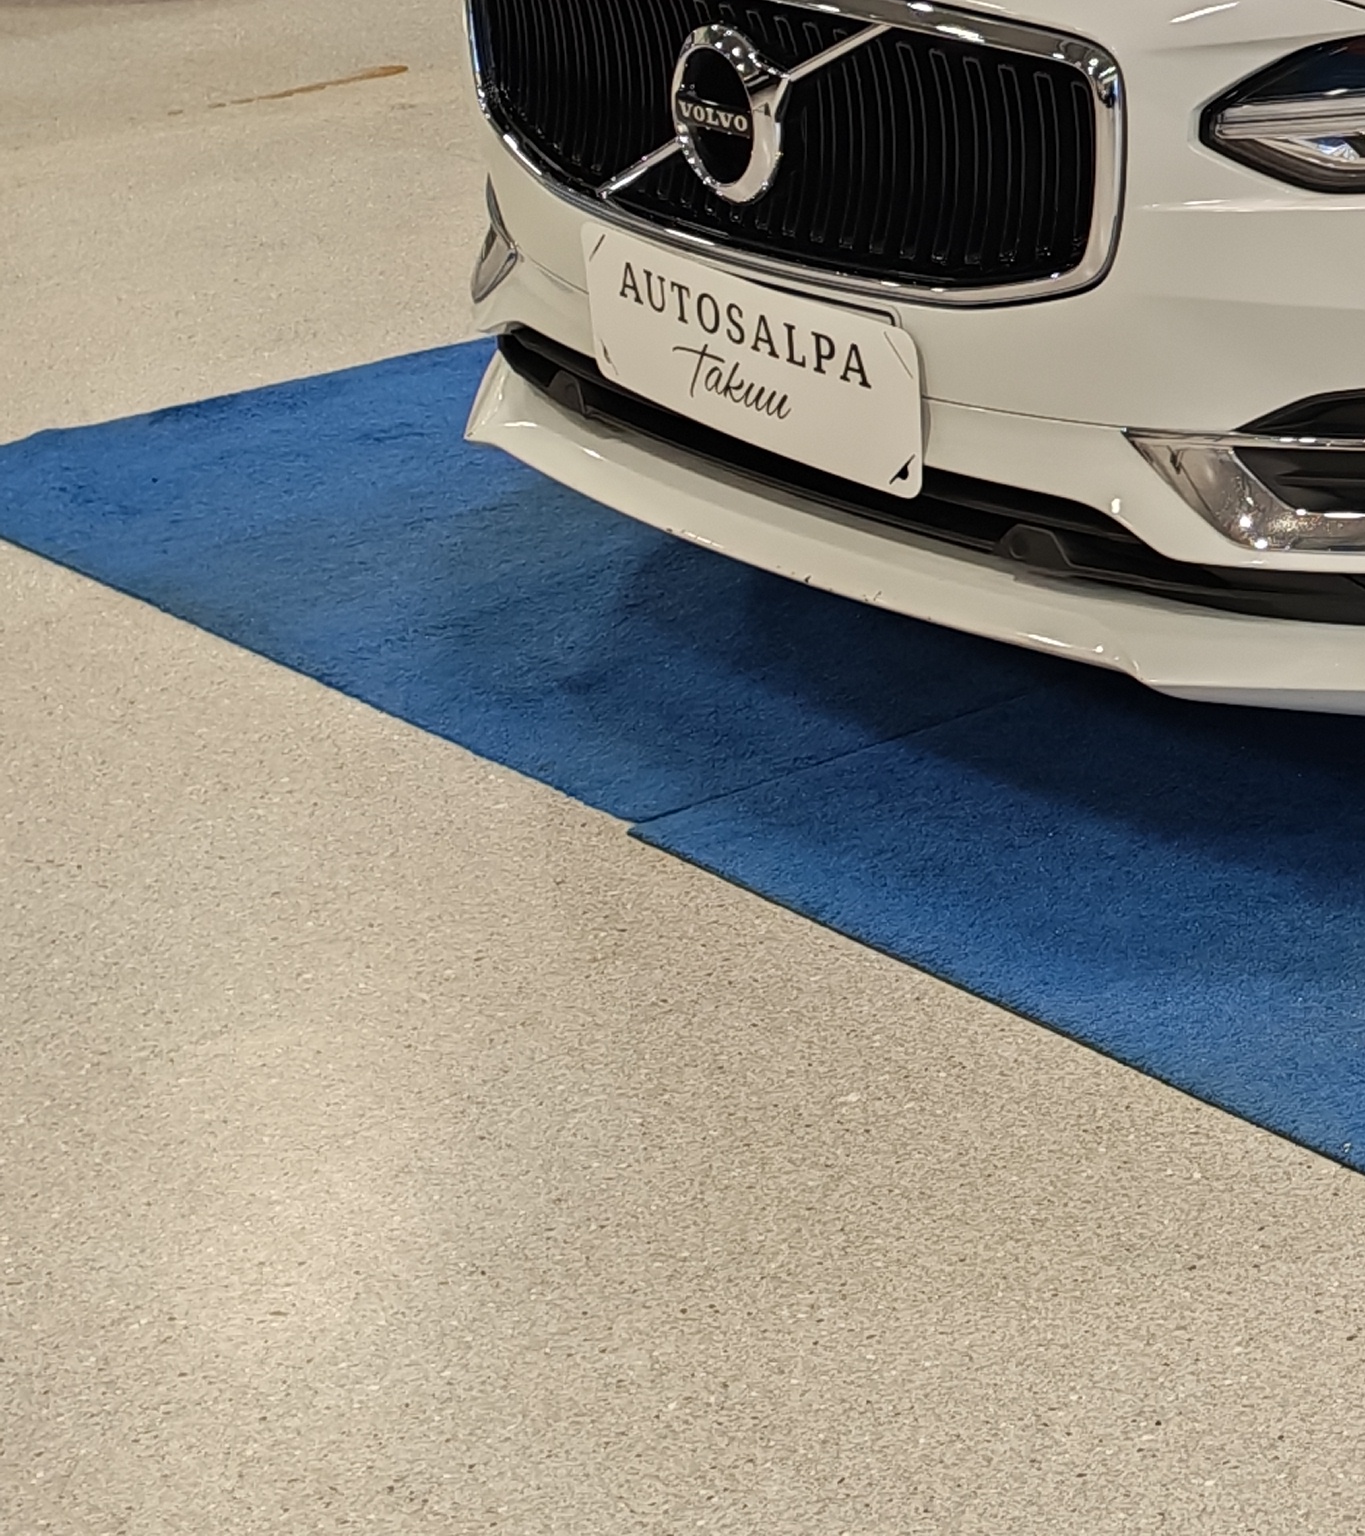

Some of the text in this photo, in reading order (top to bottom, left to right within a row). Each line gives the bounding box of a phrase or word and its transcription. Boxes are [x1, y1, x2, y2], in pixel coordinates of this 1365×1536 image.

[678, 99, 749, 133] VOLVO
[618, 262, 872, 389] AUTOSALPA
[672, 343, 792, 419] Takuu
